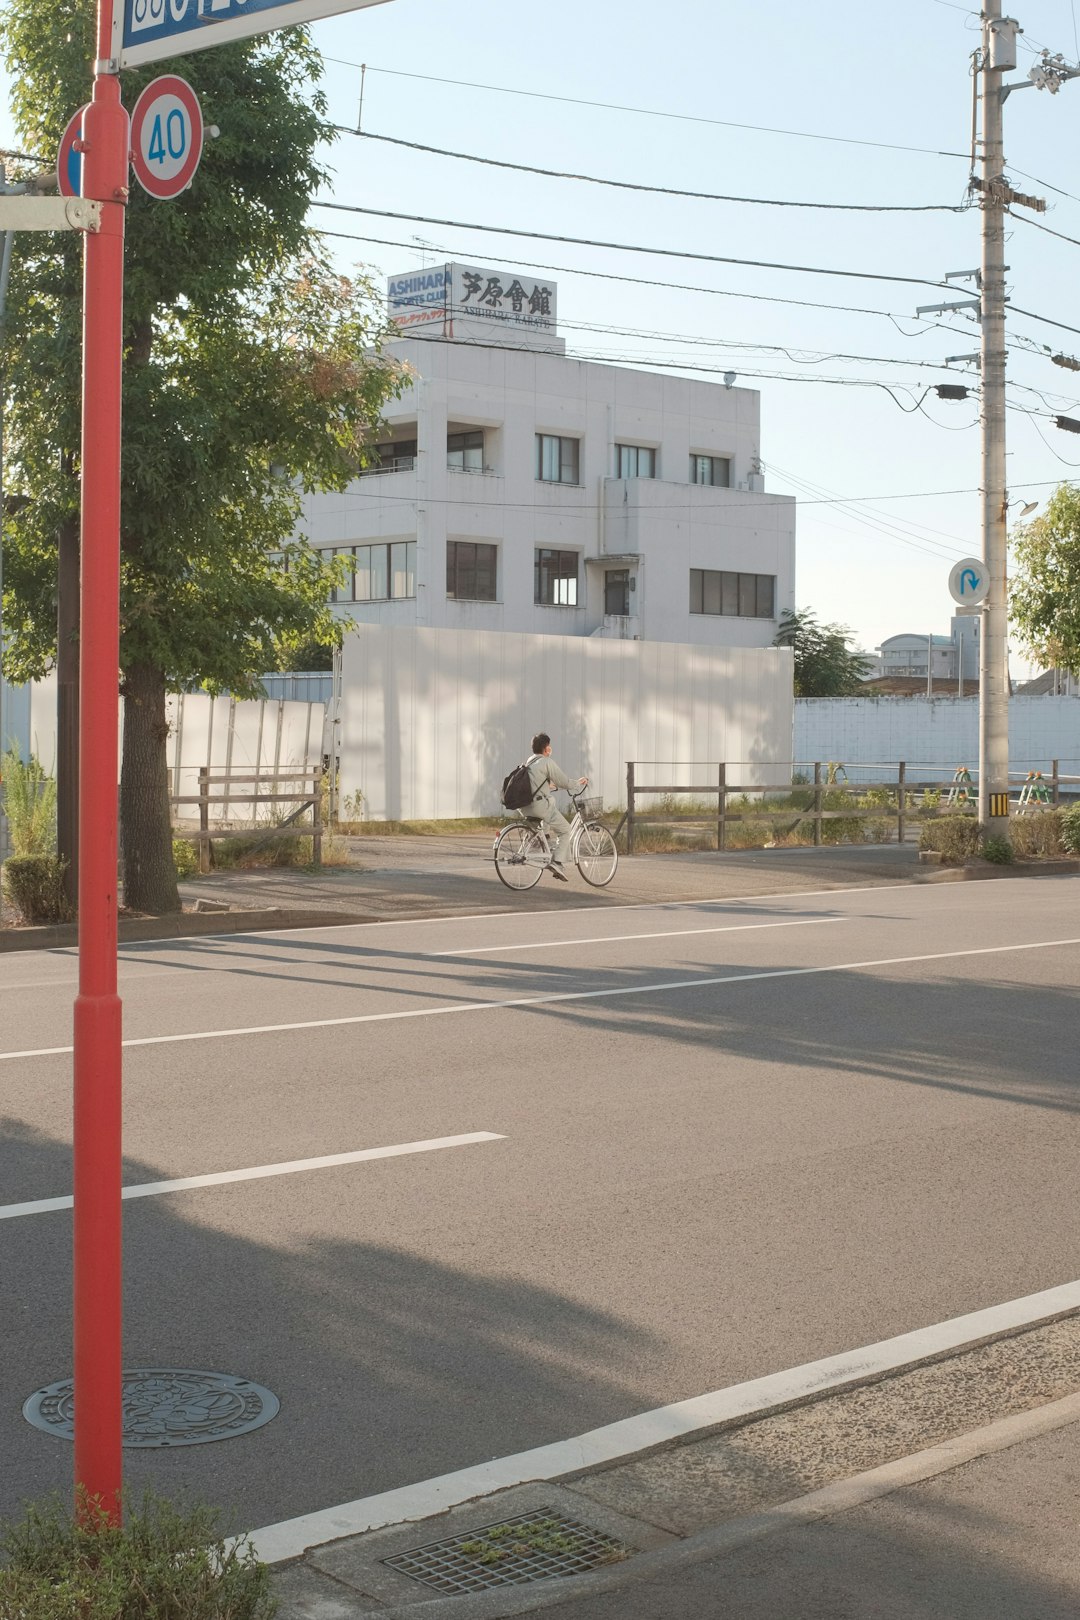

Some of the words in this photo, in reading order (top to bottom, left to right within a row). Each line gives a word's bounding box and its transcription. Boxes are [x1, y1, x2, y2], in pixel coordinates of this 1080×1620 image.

[148, 108, 186, 165] 40
[389, 270, 452, 296] ASHIHARA
[427, 289, 448, 302] CLUB
